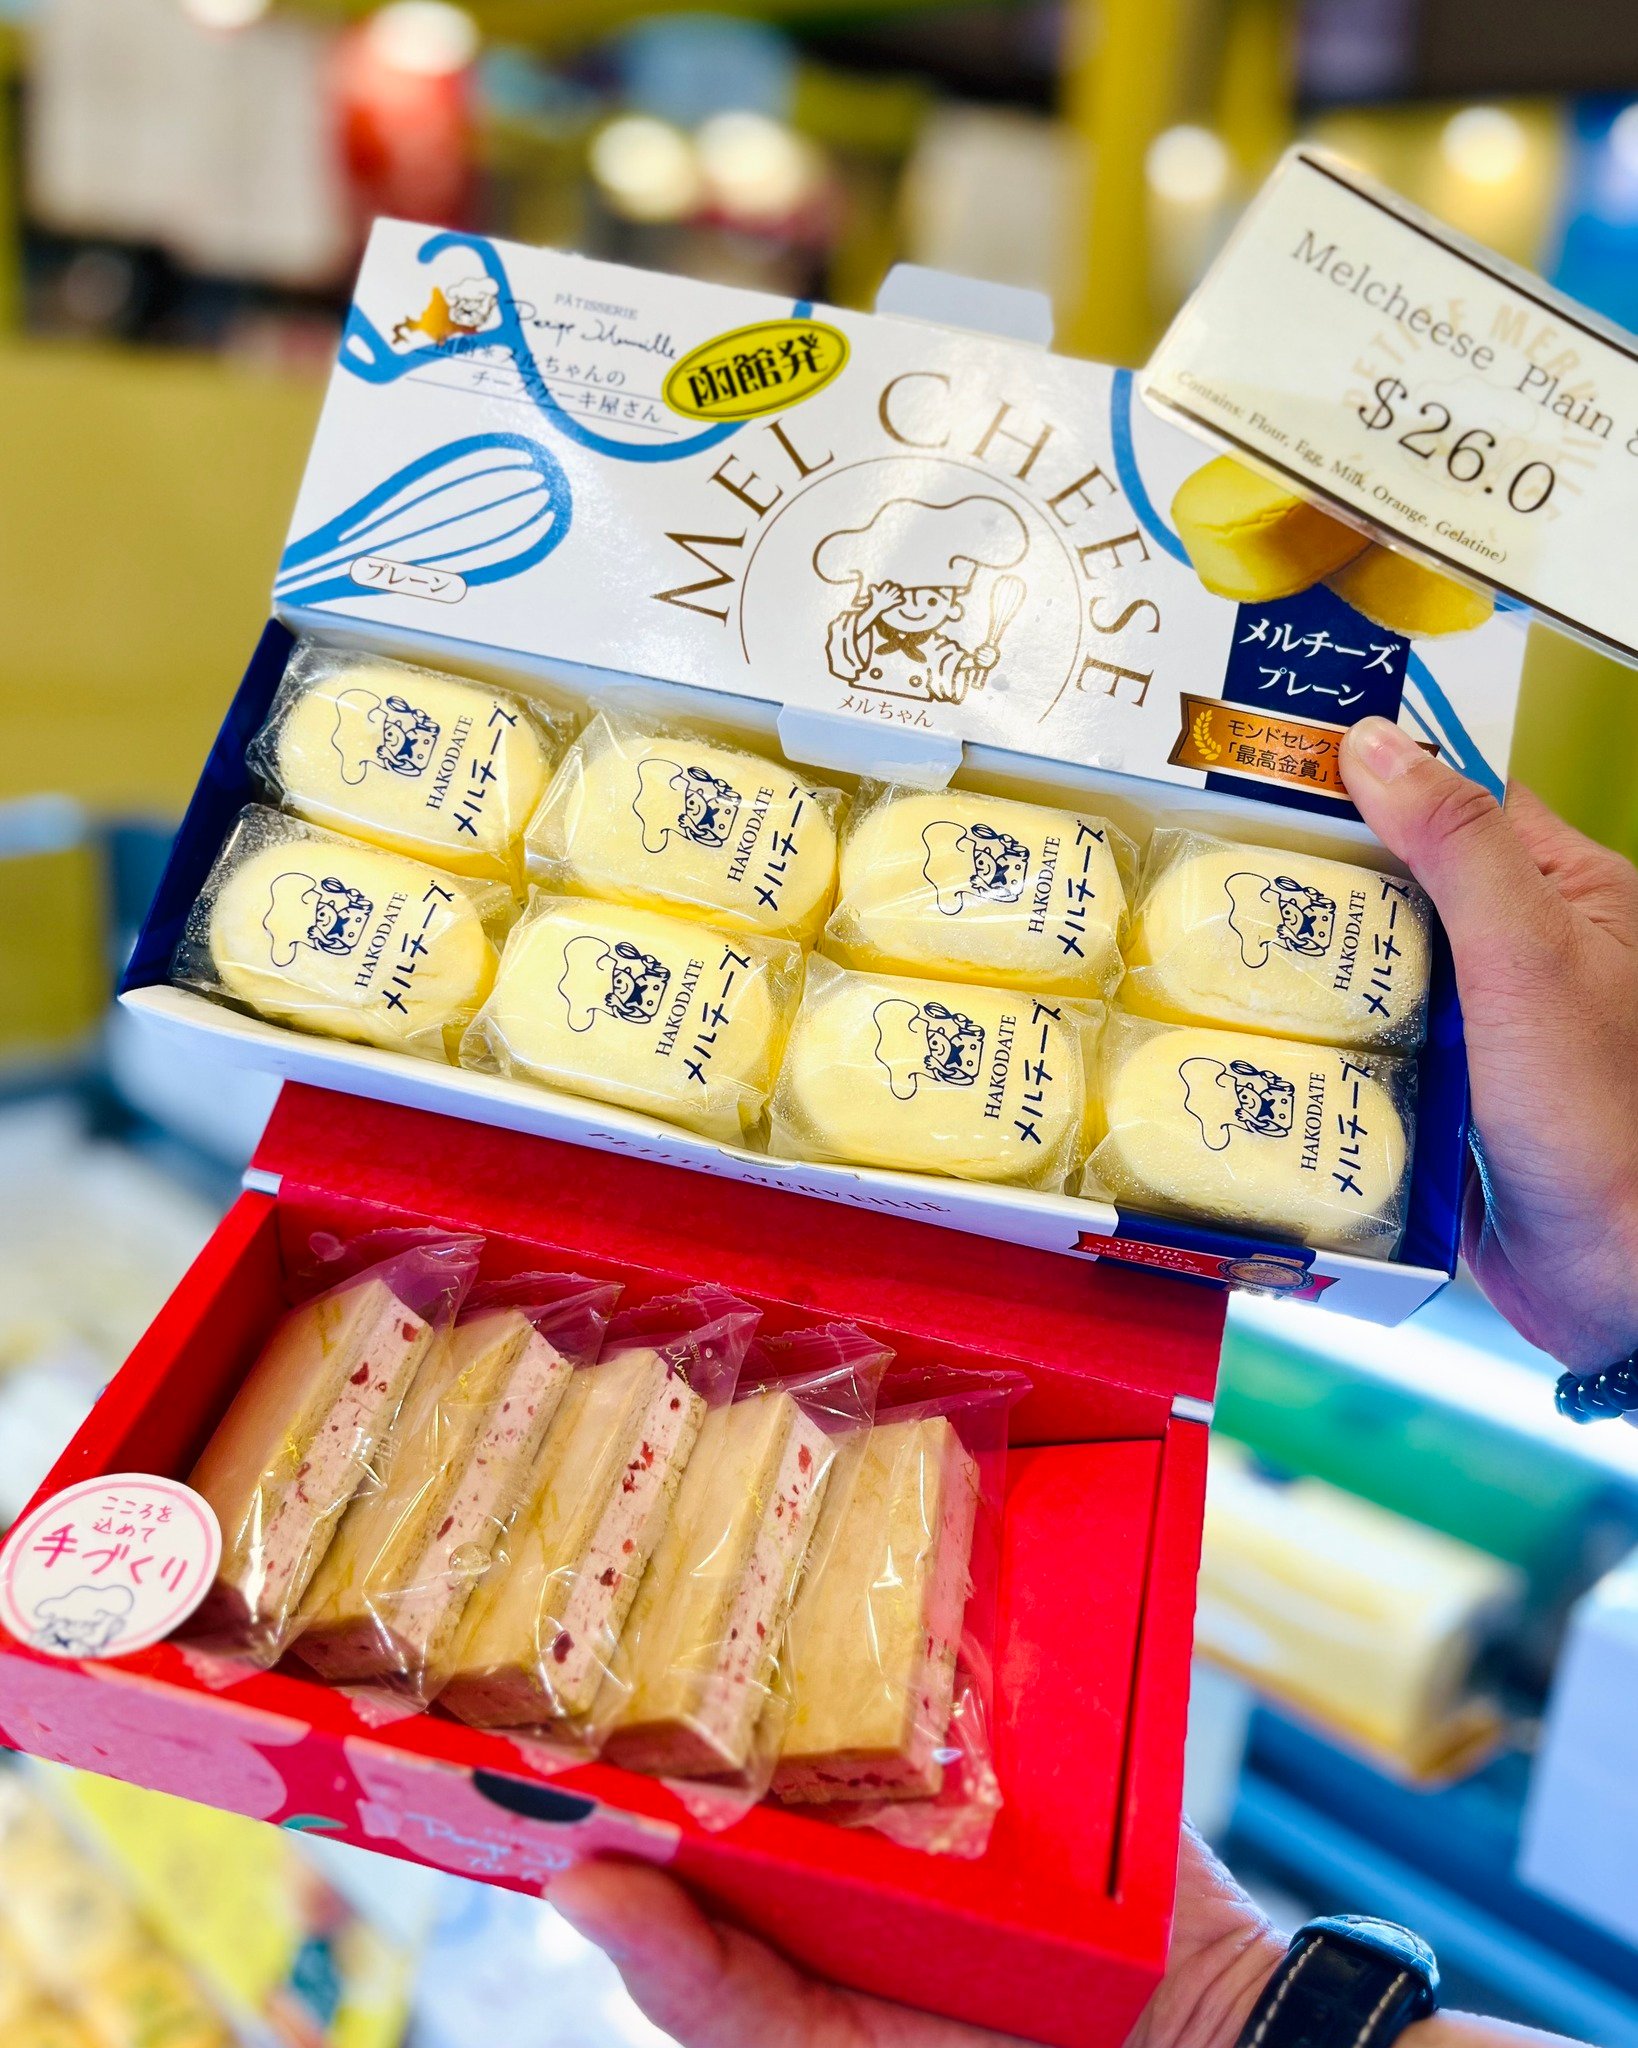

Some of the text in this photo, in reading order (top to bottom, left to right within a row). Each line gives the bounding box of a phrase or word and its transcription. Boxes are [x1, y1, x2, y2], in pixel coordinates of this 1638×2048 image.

[686, 331, 829, 408] 函館発
[1290, 231, 1614, 441] Melcheese Plain
[1248, 411, 1290, 447] Flour,
[1294, 439, 1324, 469] Egg,
[1329, 459, 1367, 494] Milk,
[1372, 485, 1430, 528] Orange,
[1434, 520, 1509, 564] Gelatine)
[1358, 377, 1556, 514] $26.0
[368, 563, 452, 593] プレーン
[650, 371, 1161, 709] MEL CHEESE
[1239, 618, 1401, 675] メルチーズ
[1257, 666, 1365, 707] プレーン
[426, 714, 474, 811] HAKODATE
[836, 694, 935, 729] メルちゃん
[453, 700, 518, 837] メルチーズ
[727, 785, 775, 883] HAKODATE
[754, 782, 817, 912] メルチーズ
[1027, 836, 1061, 935] HAKODATE
[1056, 818, 1104, 959] メルチーズ
[354, 891, 409, 989] HAKODATE
[382, 879, 456, 1015] メルチーズ
[1333, 889, 1367, 992] HAKODATE
[1361, 878, 1410, 1019] メルチーズ
[654, 958, 705, 1058] HAKODATE
[683, 944, 752, 1085] メルチーズ
[984, 1013, 1017, 1120] HAKODATE
[1013, 998, 1062, 1145] メルチーズ
[1300, 1071, 1326, 1172] HAKODATE
[1332, 1053, 1371, 1196] メルチーズ
[33, 1522, 188, 1593] 手づくり
[92, 1516, 156, 1543] 込めて
[102, 1495, 173, 1522] こころを
